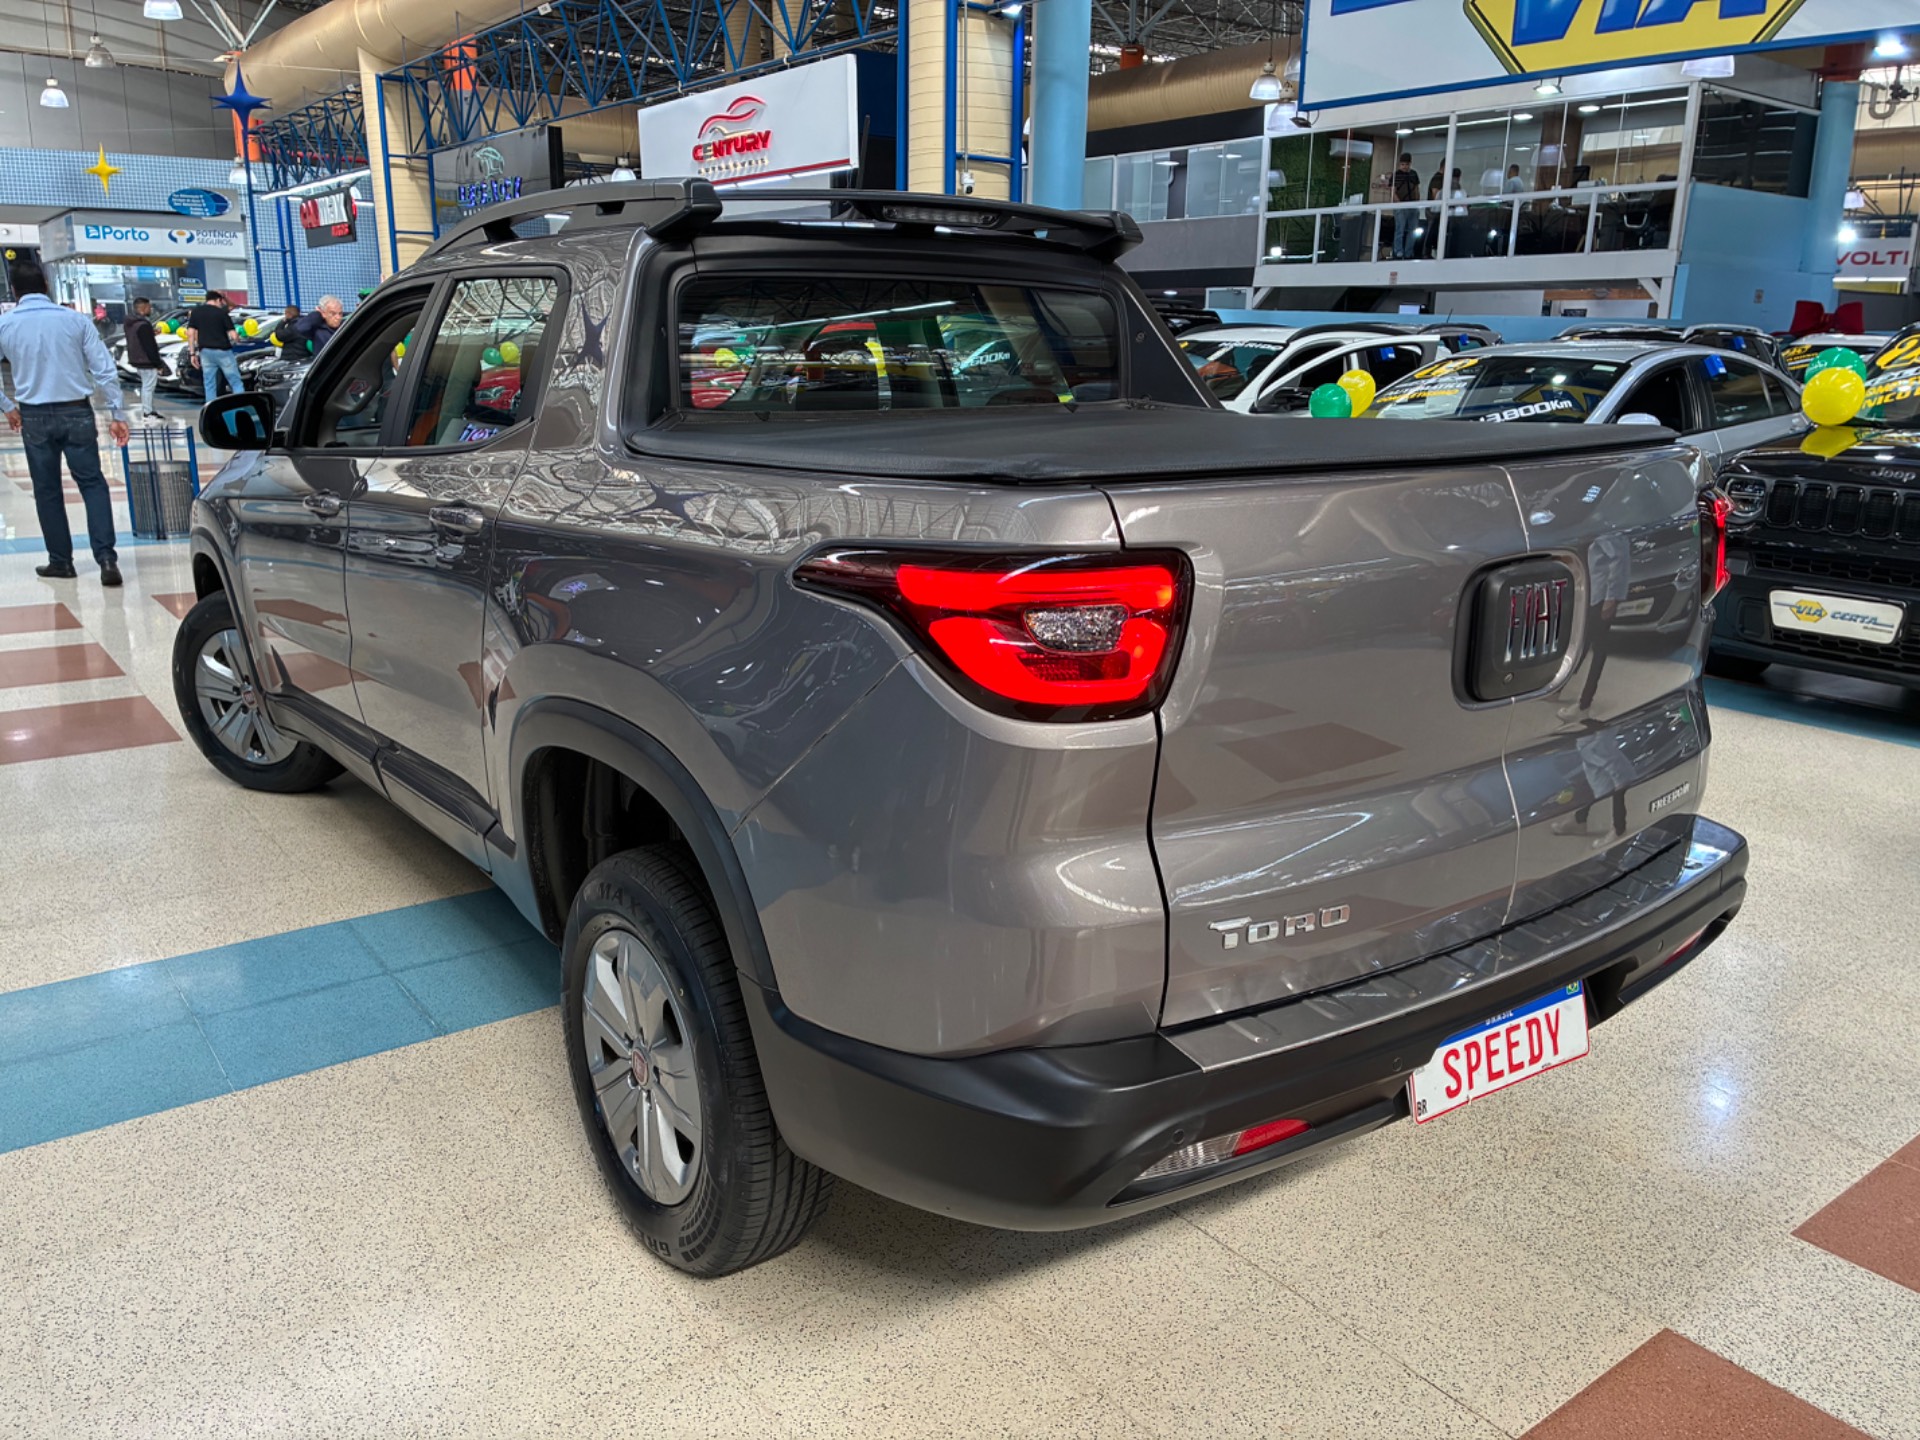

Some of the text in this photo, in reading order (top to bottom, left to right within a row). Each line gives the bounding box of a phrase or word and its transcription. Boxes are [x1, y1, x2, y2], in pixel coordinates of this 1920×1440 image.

[692, 129, 772, 162] CENTURY
[101, 225, 150, 241] Porto
[1503, 577, 1569, 663] FIAT
[1796, 605, 1879, 625] VIA CERTA
[1649, 781, 1690, 813] FREEDOM
[1208, 904, 1351, 949] TORO
[1442, 1008, 1560, 1099] SPEEDY
[1416, 1099, 1428, 1117] BR
